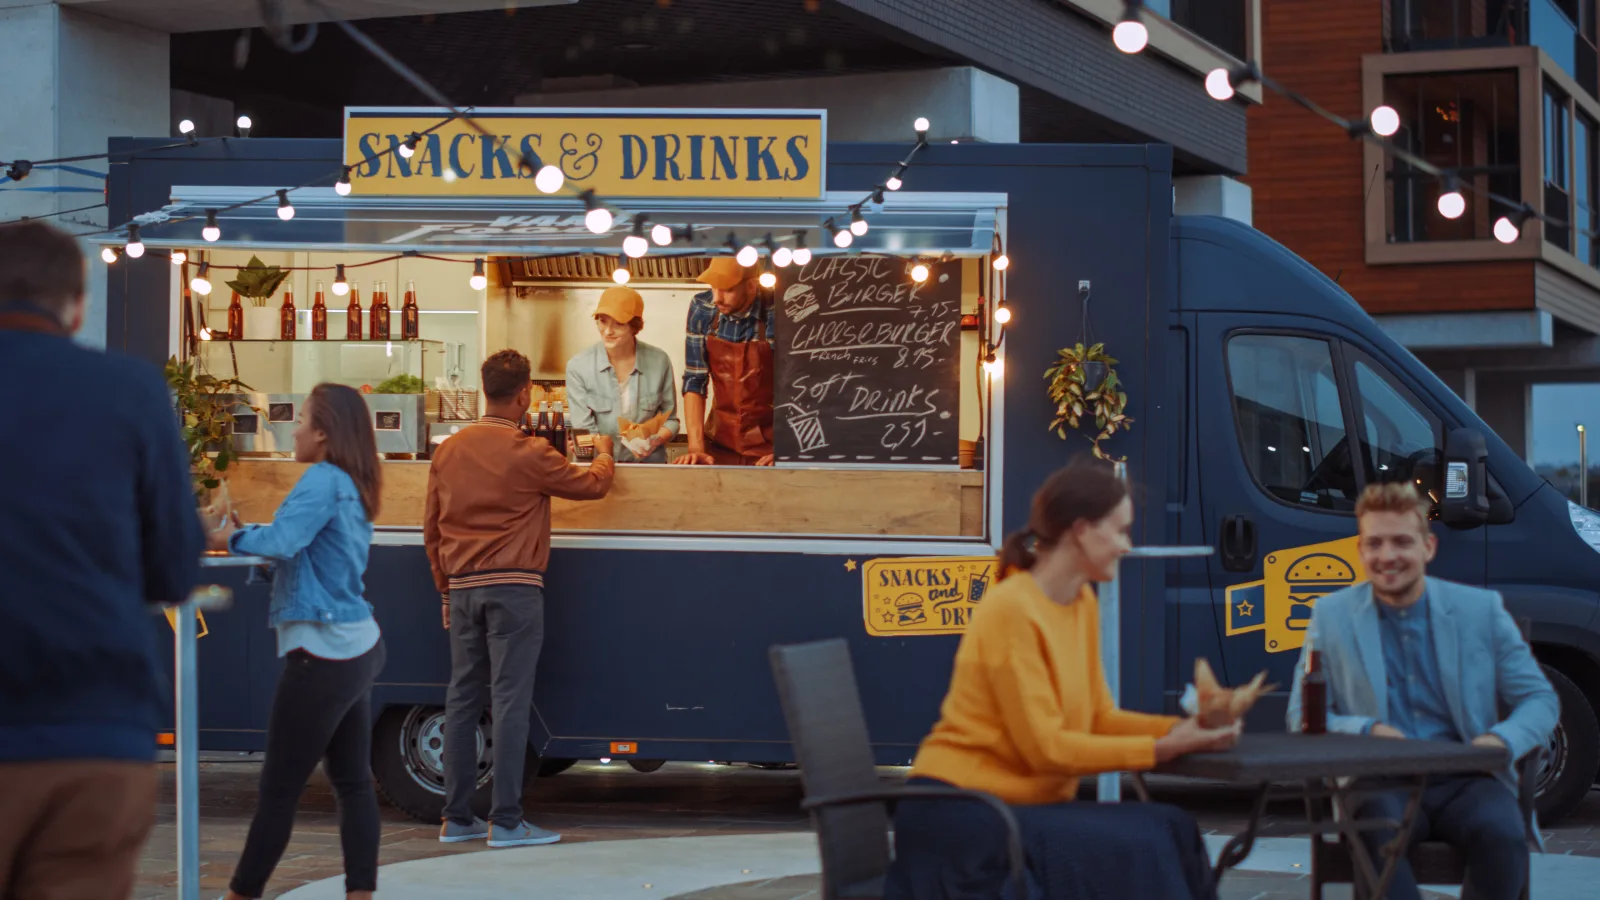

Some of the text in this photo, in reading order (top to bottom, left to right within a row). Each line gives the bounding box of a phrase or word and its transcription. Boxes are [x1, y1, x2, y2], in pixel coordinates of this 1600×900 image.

[356, 132, 810, 181] SNACKS & DRINKS
[880, 568, 952, 588] SNACKS
[928, 578, 964, 605] and
